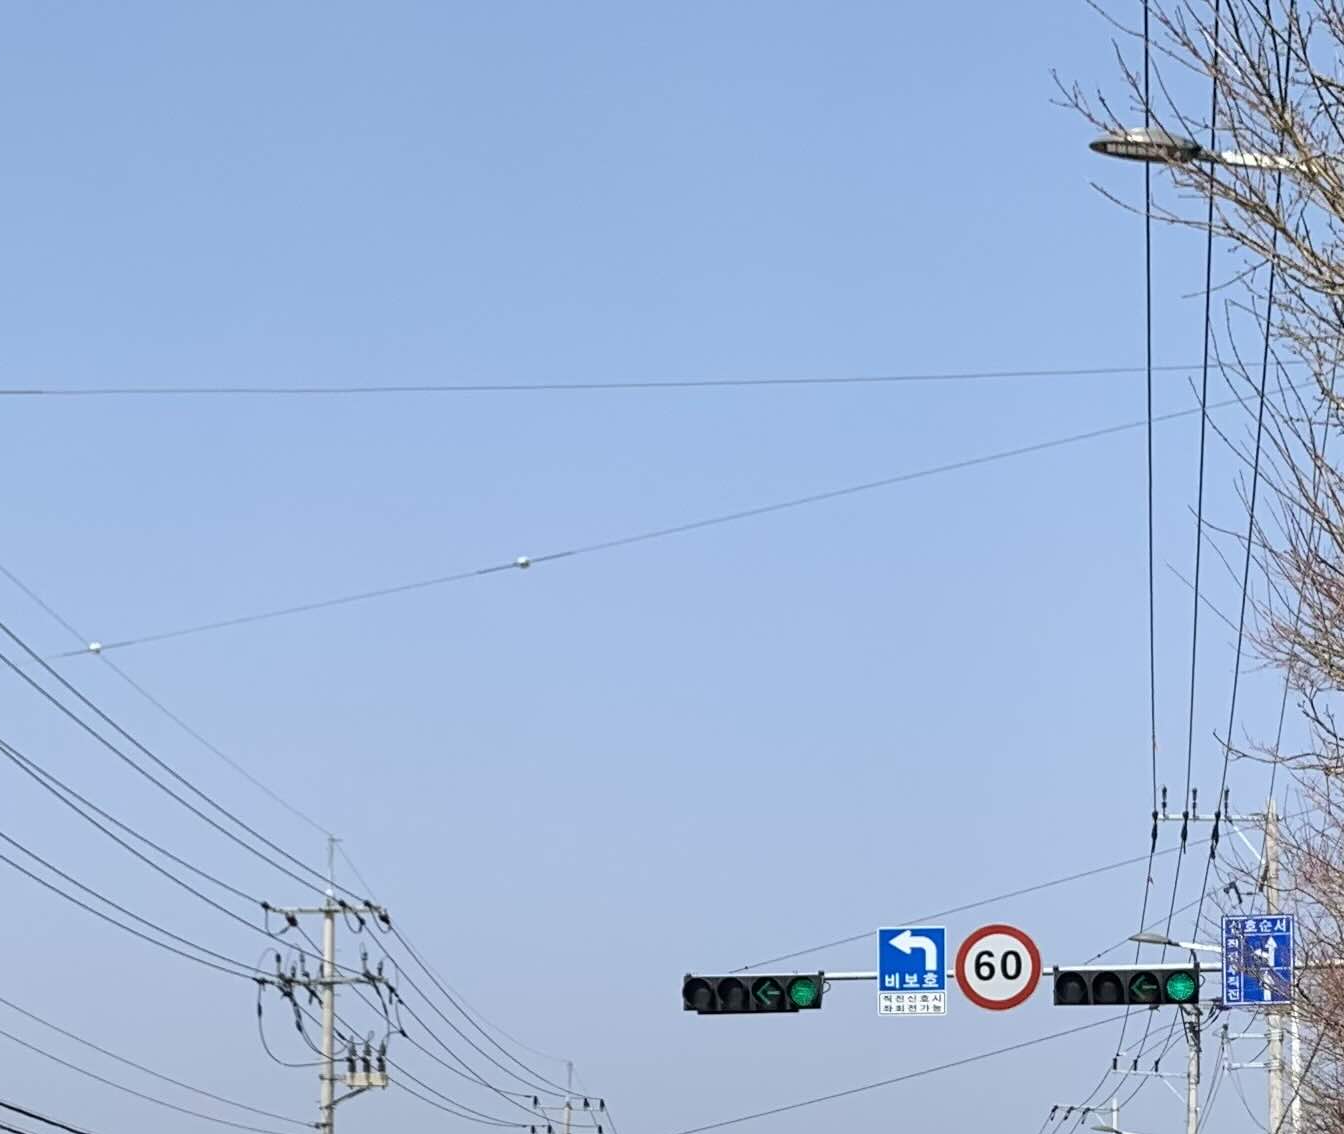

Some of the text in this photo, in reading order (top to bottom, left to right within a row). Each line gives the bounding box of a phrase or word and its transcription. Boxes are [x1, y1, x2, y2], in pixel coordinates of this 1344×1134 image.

[1229, 919, 1286, 933] 신호순서
[974, 950, 1022, 981] 60
[884, 972, 939, 989] 비보호
[883, 994, 942, 1003] 직진신호시
[883, 1003, 942, 1012] 좌회전가능
